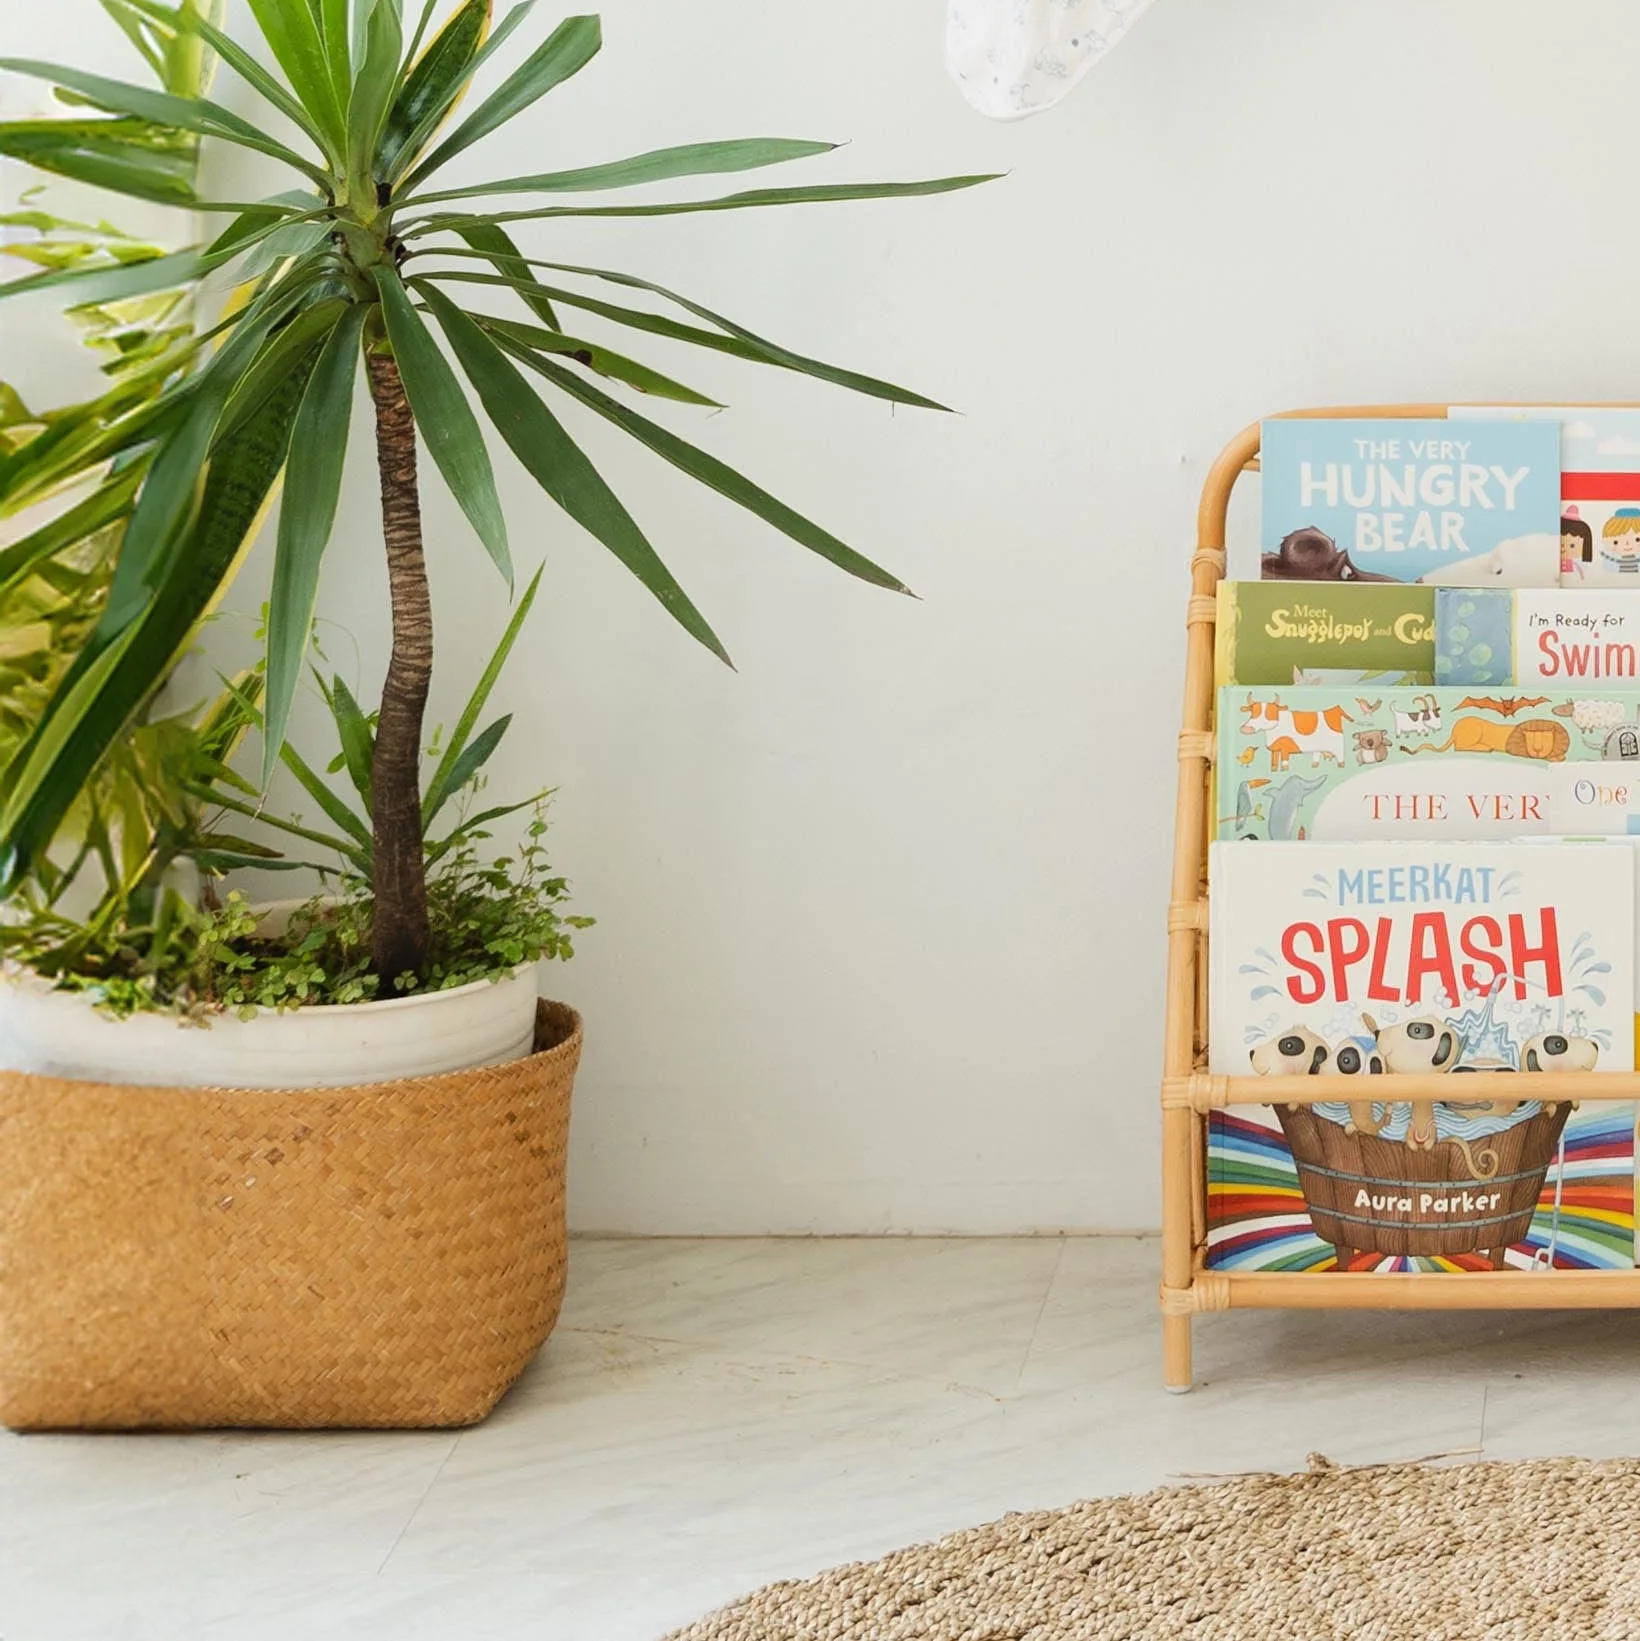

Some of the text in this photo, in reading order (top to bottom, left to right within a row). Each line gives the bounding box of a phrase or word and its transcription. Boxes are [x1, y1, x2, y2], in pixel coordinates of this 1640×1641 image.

[1354, 439, 1472, 460] THE VERY
[1301, 462, 1531, 510] HUNGRY
[1356, 511, 1469, 553] BEAR
[1293, 604, 1327, 618] Meet
[1529, 613, 1625, 631] I'm Ready for
[1264, 609, 1374, 644] Snugglepot
[1374, 626, 1392, 636] and
[1573, 778, 1629, 806] One
[1364, 793, 1552, 821] THE VER
[1338, 863, 1496, 907] MEERKAT
[1280, 907, 1563, 1008] SPLASH
[1354, 1188, 1501, 1213] Aura Parker
